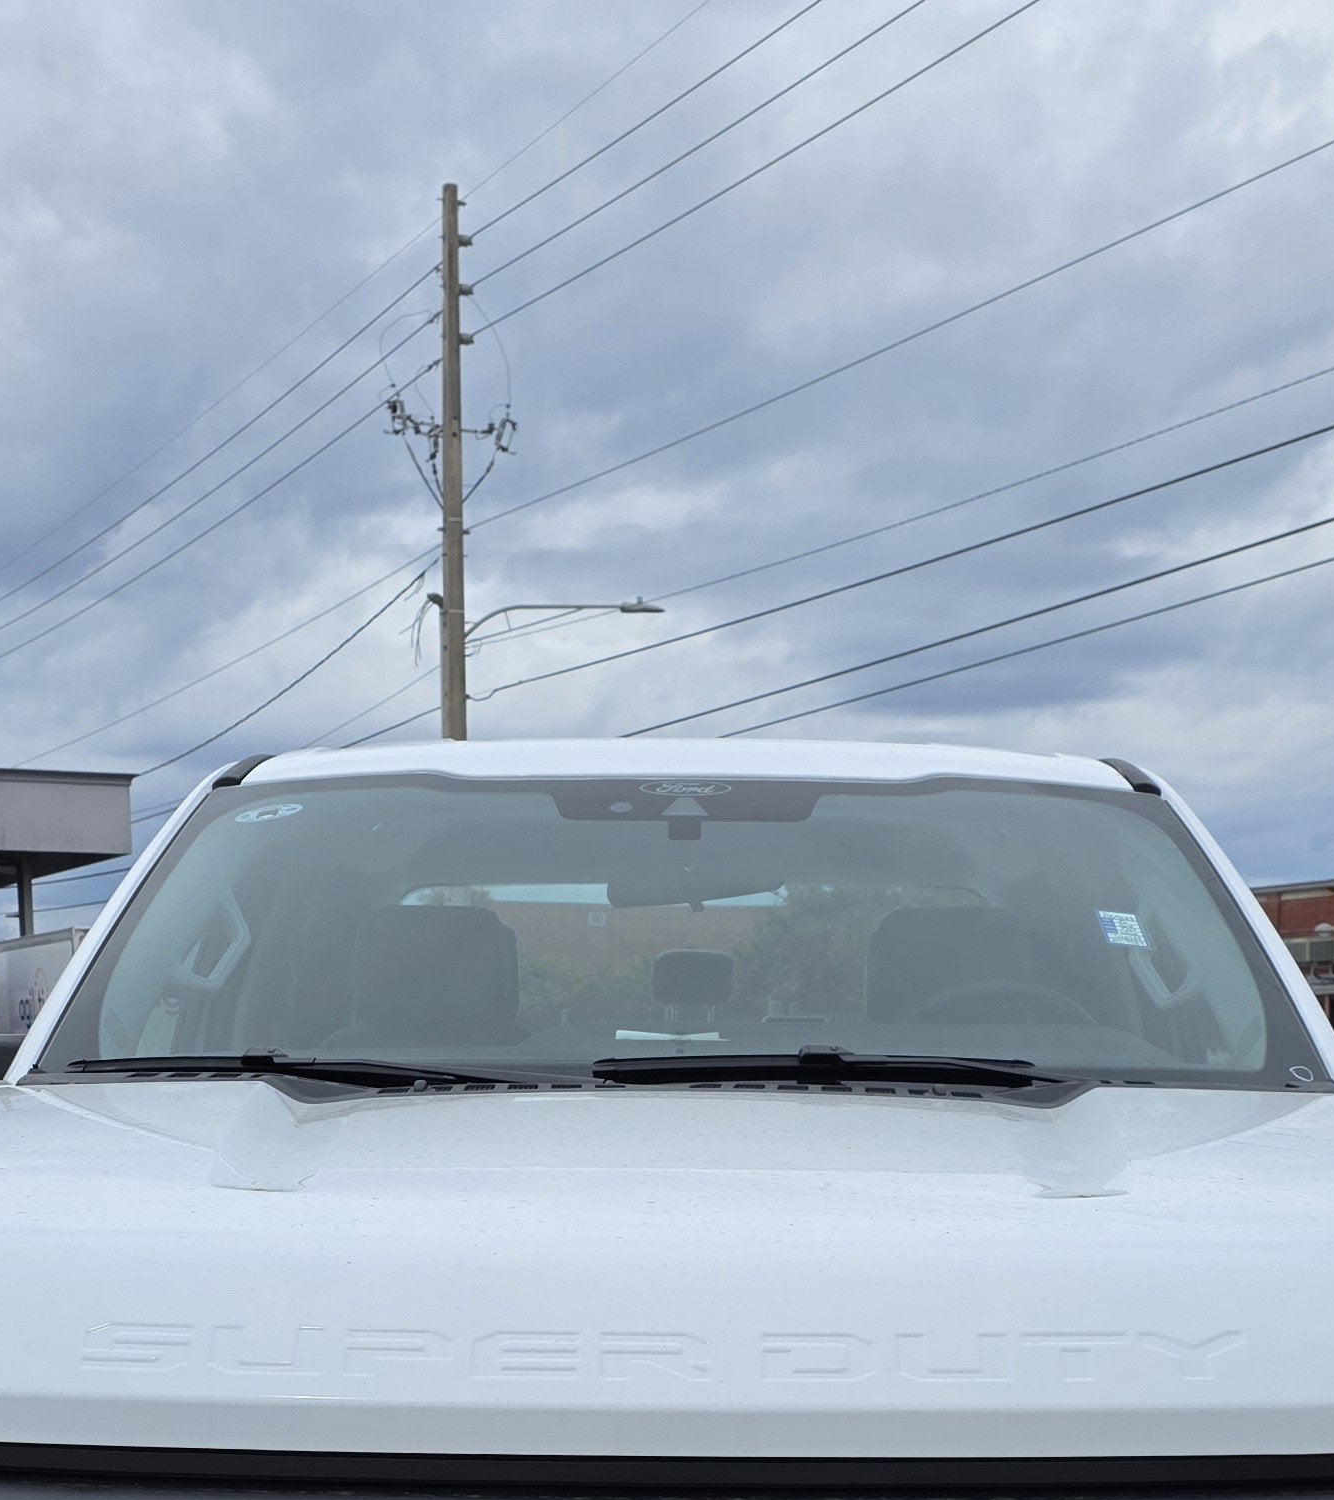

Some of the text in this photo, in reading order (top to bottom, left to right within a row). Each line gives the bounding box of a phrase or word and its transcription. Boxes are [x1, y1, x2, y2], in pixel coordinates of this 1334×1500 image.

[655, 782, 715, 794] Ford
[78, 1320, 1248, 1383] SUPER DUTY
